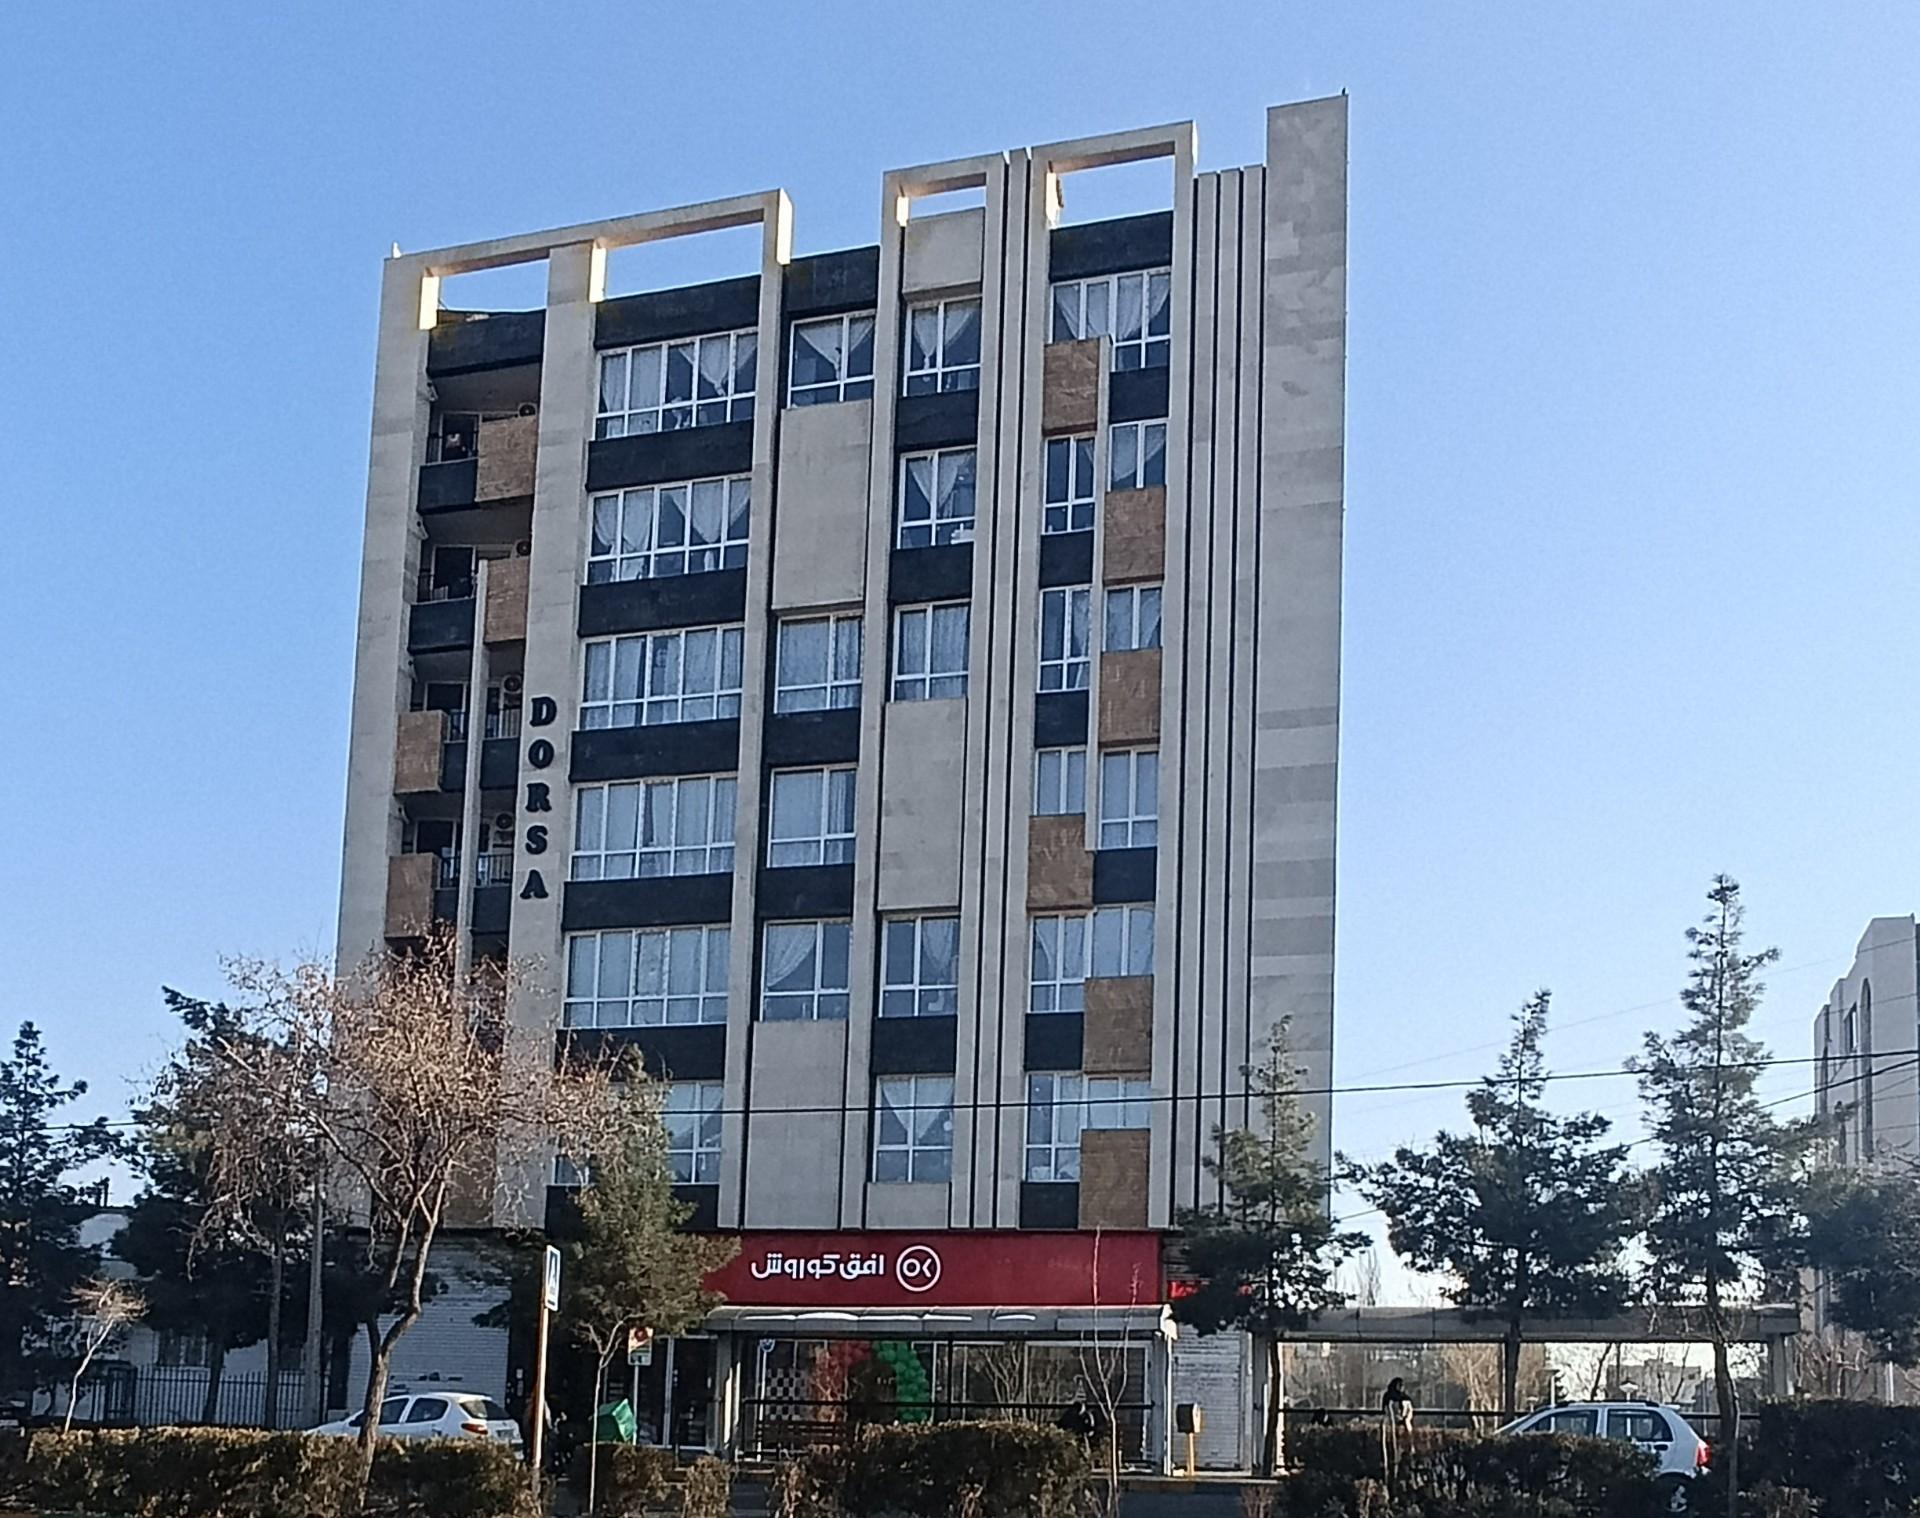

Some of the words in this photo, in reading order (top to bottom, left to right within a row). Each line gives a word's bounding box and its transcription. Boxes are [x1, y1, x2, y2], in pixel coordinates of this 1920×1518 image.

[520, 696, 557, 899] DORSA
[751, 1253, 840, 1279] کوروش
[839, 1253, 885, 1280] افق
